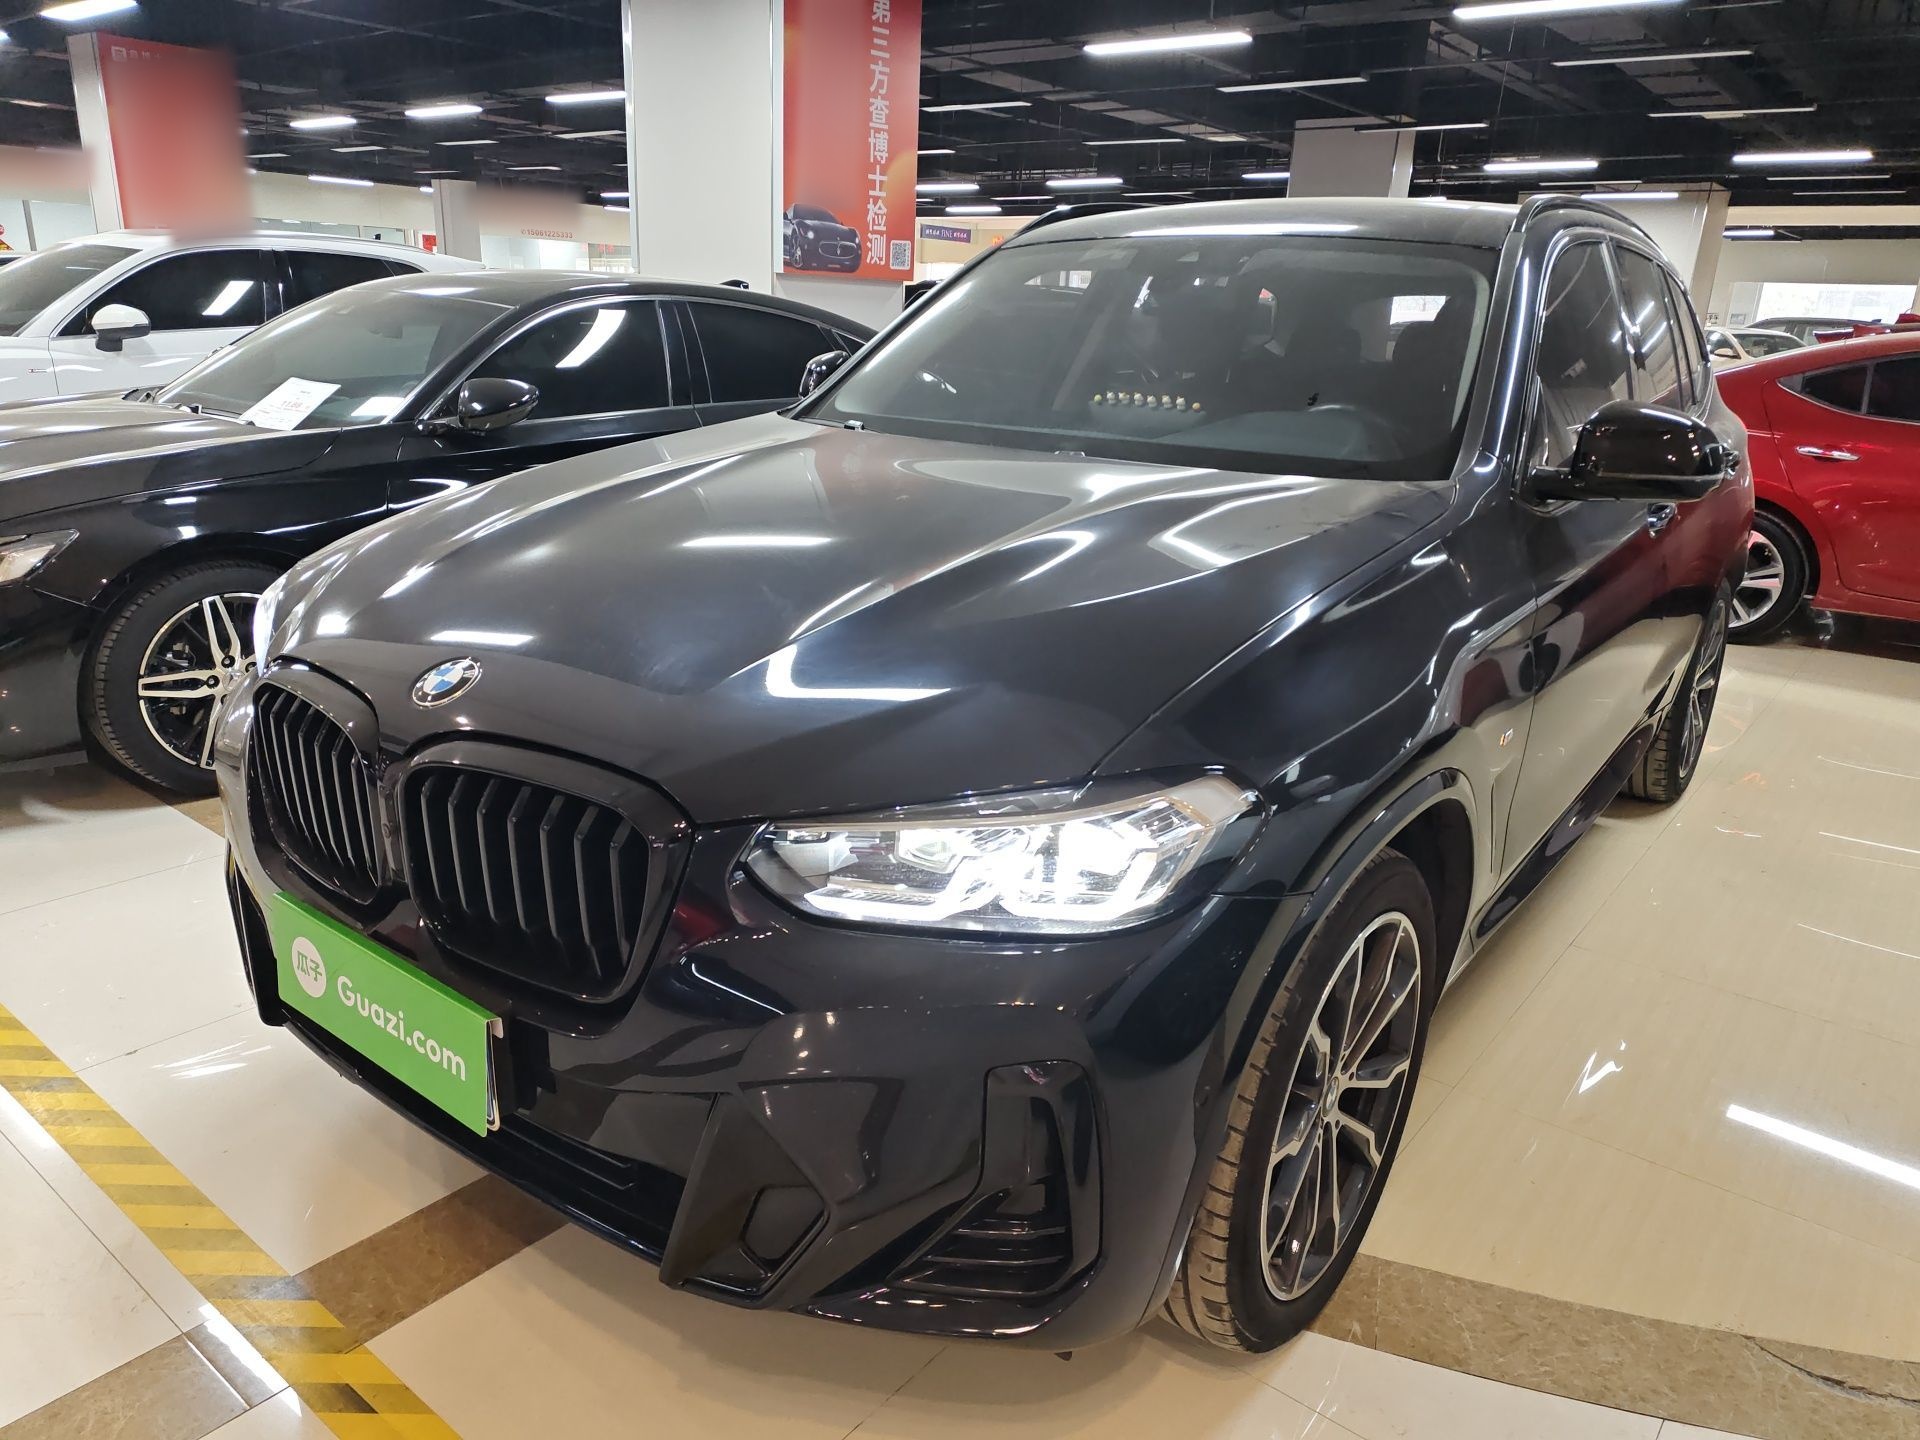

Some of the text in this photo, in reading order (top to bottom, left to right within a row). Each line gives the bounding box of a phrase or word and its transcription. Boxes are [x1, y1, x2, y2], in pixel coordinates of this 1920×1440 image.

[867, 0, 890, 265] 第三方查博士检测
[296, 950, 323, 983] 瓜子
[337, 975, 466, 1081] Guazi.com
